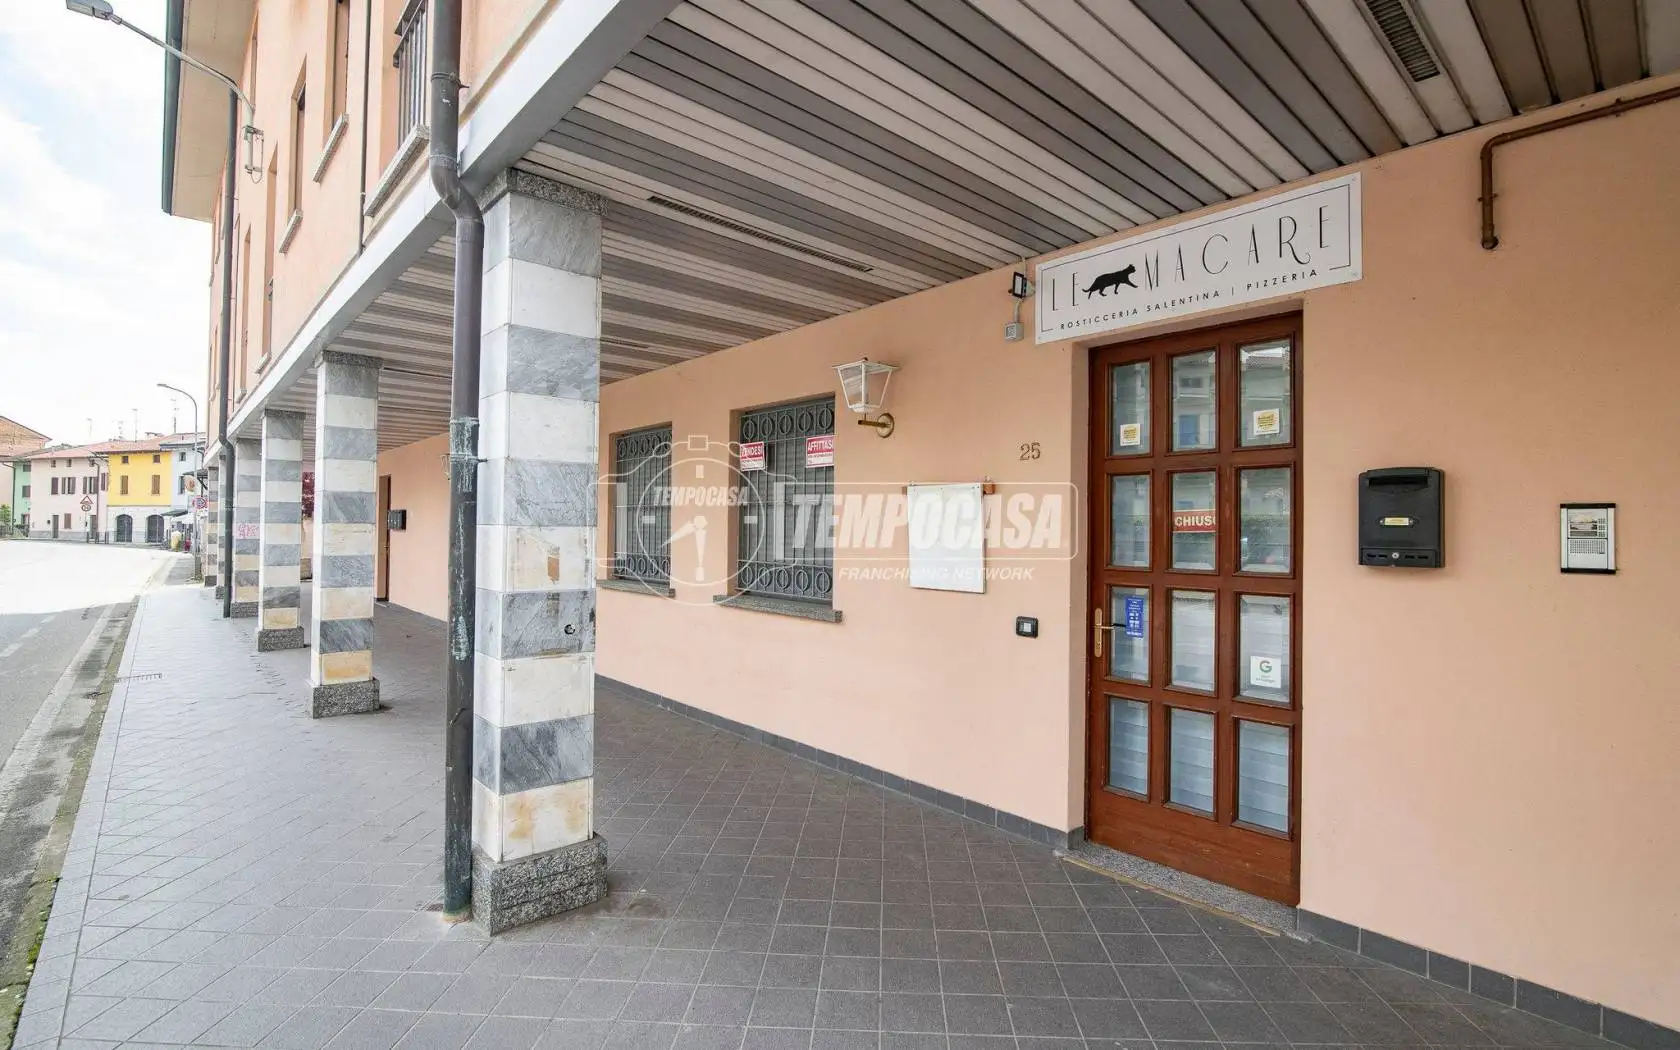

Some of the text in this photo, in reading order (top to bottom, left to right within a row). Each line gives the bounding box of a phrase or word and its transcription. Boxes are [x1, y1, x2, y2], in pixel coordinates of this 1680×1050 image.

[1051, 271, 1080, 312] LE
[1059, 307, 1139, 331] ROSTICCERIA
[1146, 285, 1221, 312] SALENTINA
[1246, 268, 1318, 292] PIZZERIA
[1019, 442, 1042, 461] 25
